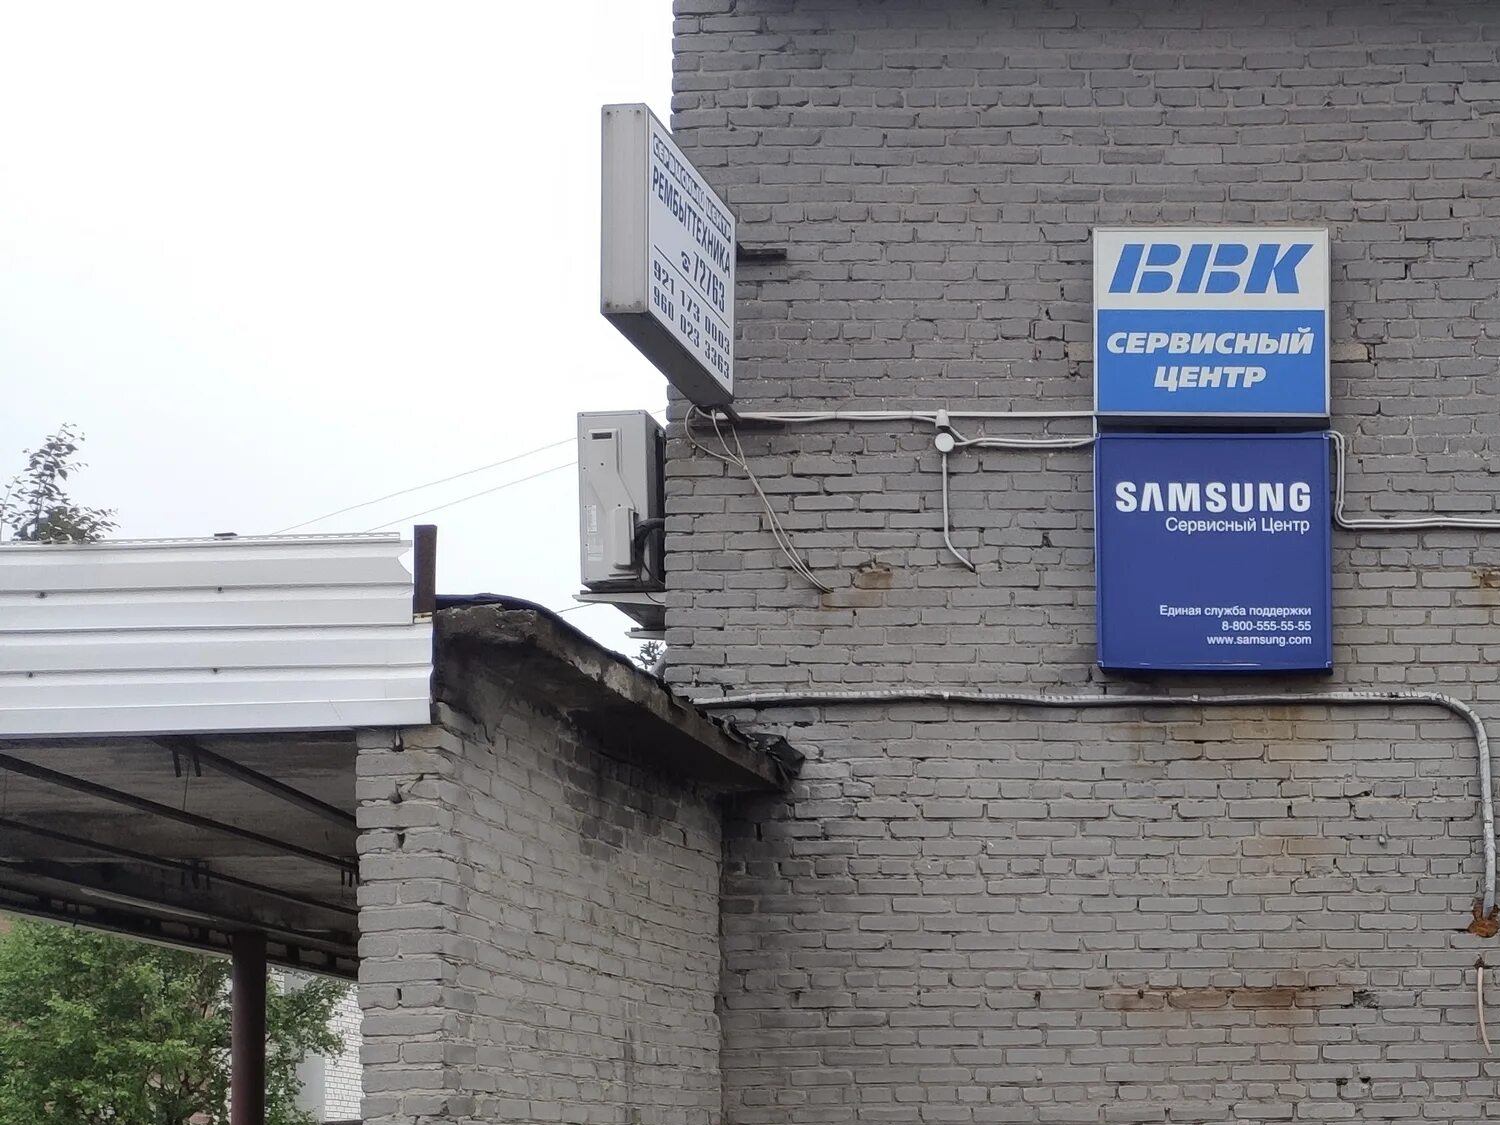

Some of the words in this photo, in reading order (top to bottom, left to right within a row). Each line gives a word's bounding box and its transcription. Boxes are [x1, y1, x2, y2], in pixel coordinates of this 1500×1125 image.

[652, 165, 731, 279] РЕМБЫТТЕХНИКА
[693, 250, 725, 313] 72763
[653, 259, 675, 296] 921
[680, 289, 700, 323] 173
[704, 315, 730, 356] 0003
[653, 285, 674, 321] 960
[680, 314, 700, 348] 023
[704, 341, 730, 380] 3363
[1106, 327, 1314, 355] СЕРВИСНЫЙ
[1153, 365, 1267, 392] ЦЕНТР
[1115, 481, 1311, 513] SAMSUNG
[1165, 517, 1257, 535] Сервисный
[1261, 517, 1310, 535] Центр
[1159, 605, 1201, 618] Единая
[1204, 605, 1247, 618] служба
[1249, 606, 1312, 618] поддержки
[1221, 620, 1312, 632] 8-800-555-55-55
[1207, 635, 1312, 647] www.samsung.com
